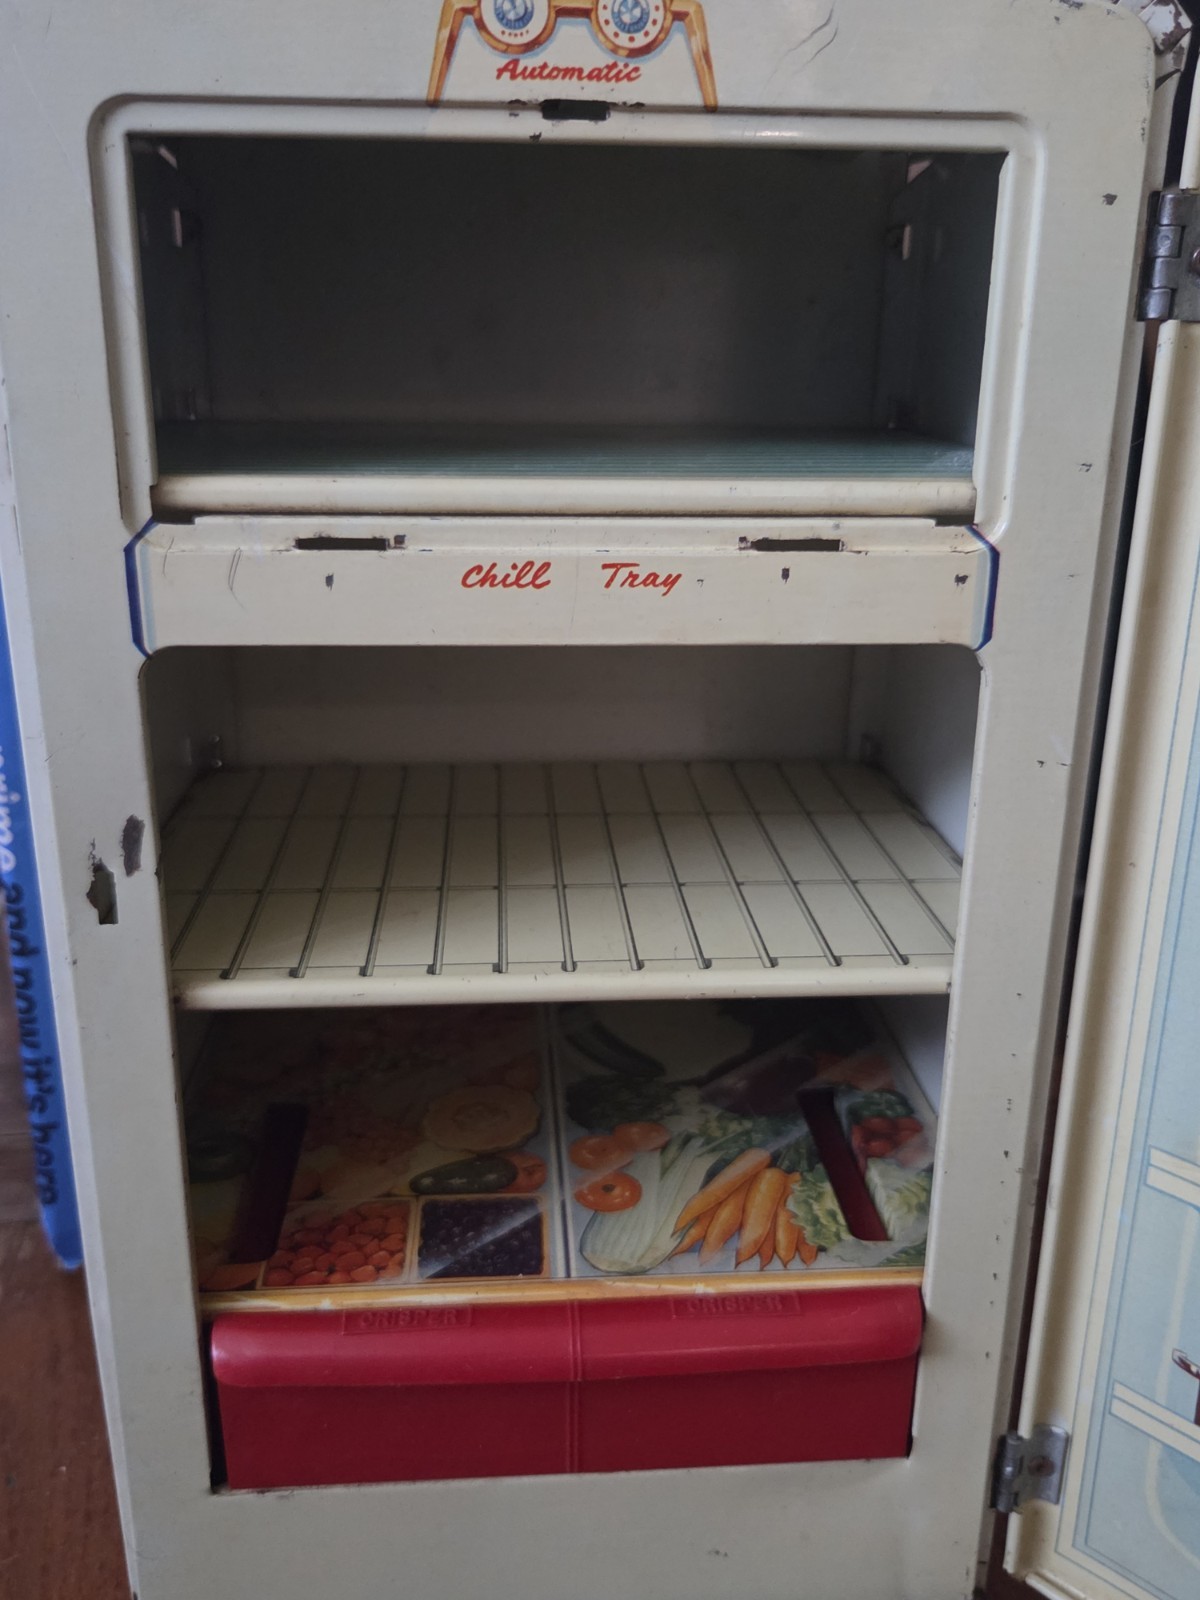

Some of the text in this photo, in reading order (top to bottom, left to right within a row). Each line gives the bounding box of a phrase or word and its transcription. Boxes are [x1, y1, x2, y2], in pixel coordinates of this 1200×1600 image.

[496, 58, 643, 83] Automatic
[461, 560, 683, 597] Chill Tray
[687, 1294, 784, 1314] CRISPER
[359, 1306, 458, 1329] CRISPER
